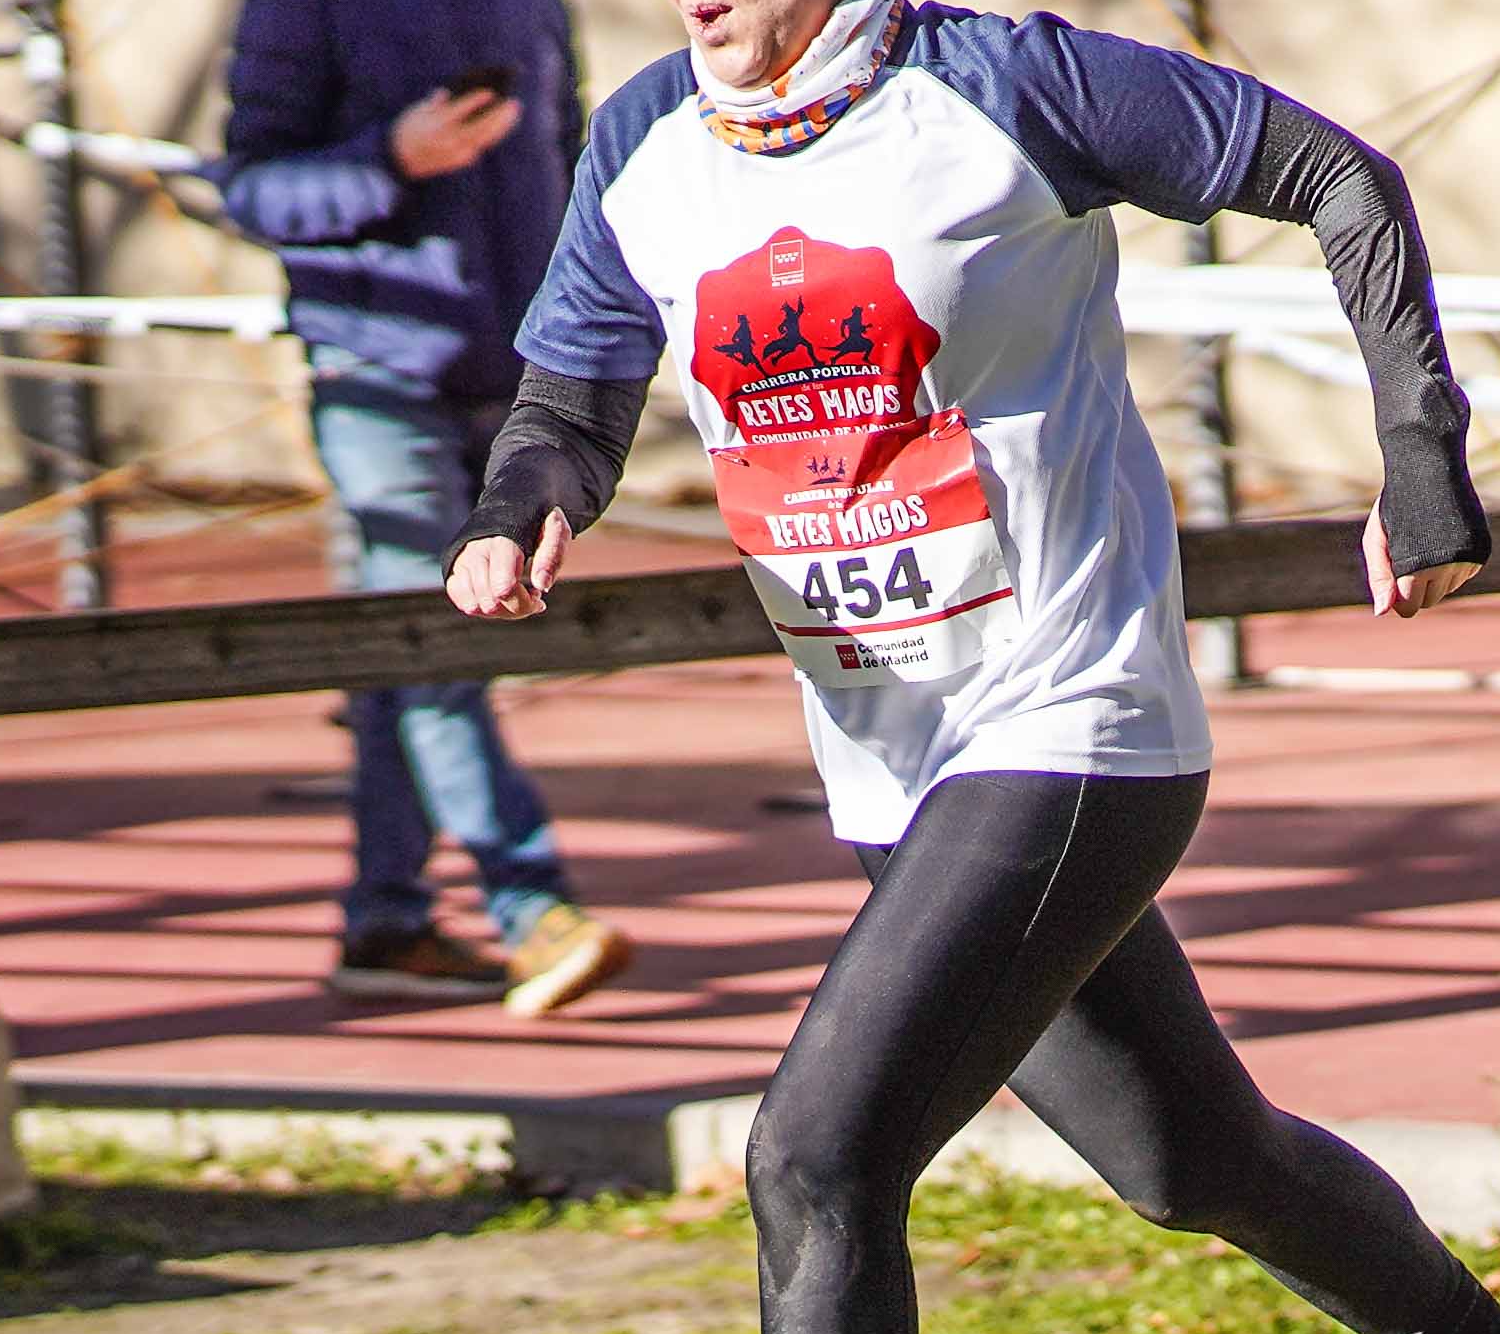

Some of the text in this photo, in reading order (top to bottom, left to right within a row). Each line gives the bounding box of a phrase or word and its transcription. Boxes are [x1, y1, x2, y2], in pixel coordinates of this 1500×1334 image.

[742, 366, 882, 393] CARRERA POPULAR
[737, 384, 901, 427] REYES MAGOS
[765, 494, 929, 549] REYES MAGOS
[803, 547, 932, 621] 454
[857, 635, 925, 654] Comunidad
[862, 649, 929, 668] de Madrid
